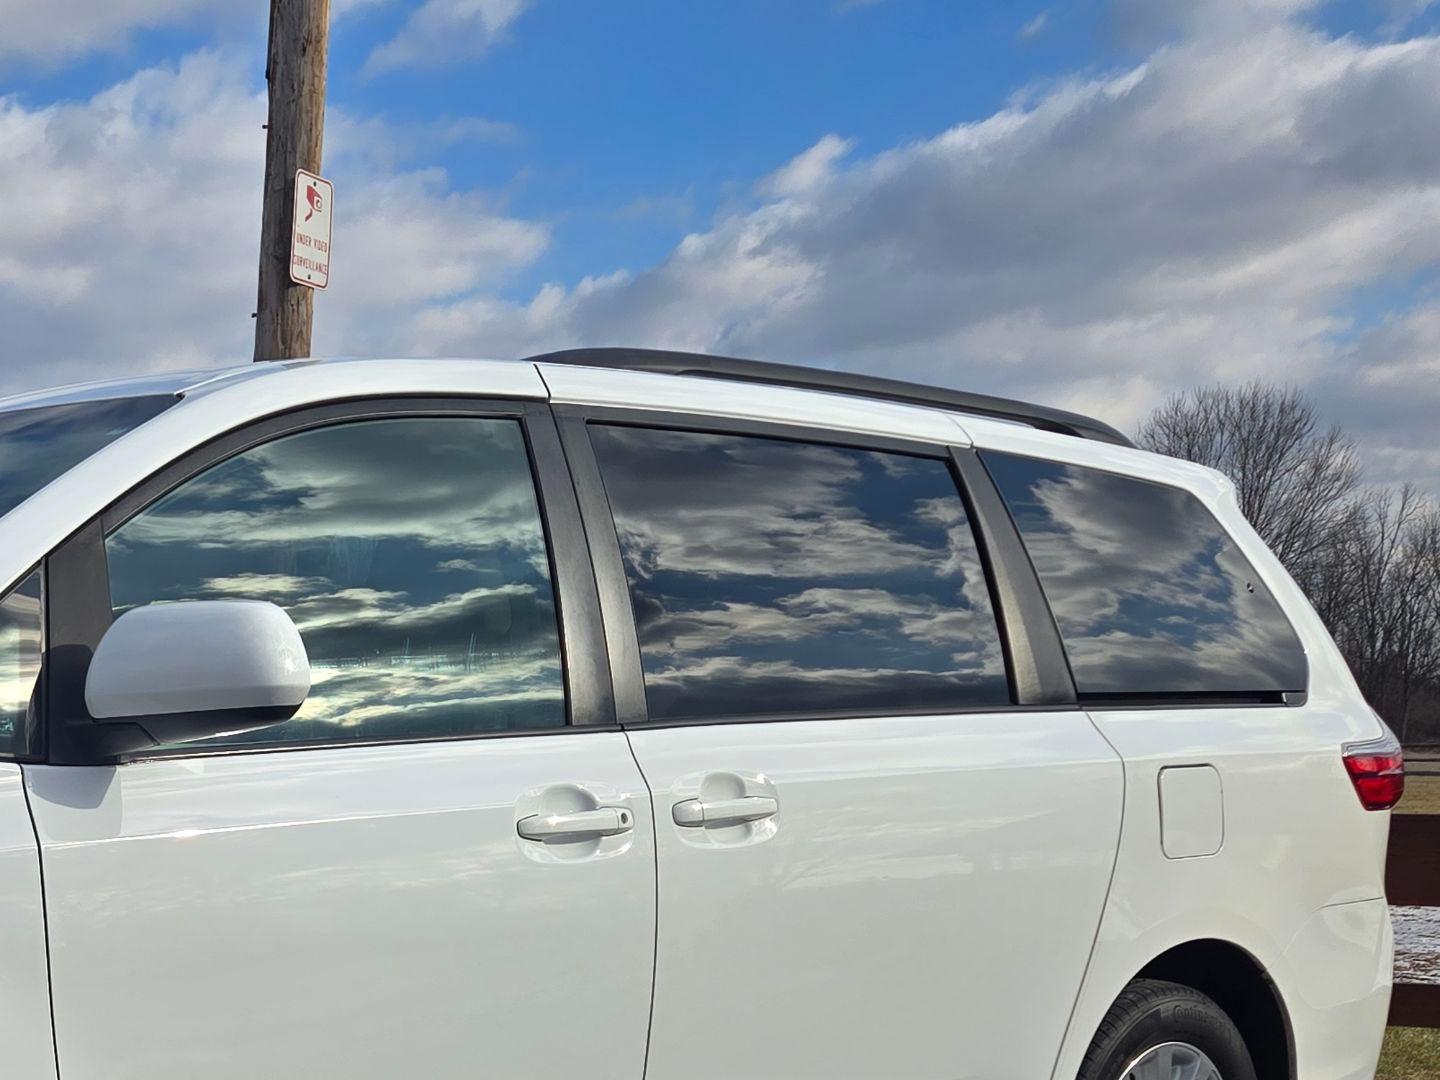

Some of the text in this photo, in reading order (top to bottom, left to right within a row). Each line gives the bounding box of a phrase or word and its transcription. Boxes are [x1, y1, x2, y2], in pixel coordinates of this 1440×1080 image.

[296, 232, 327, 253] UNDER VIDEO
[292, 254, 328, 275] SURVEILLANCE
